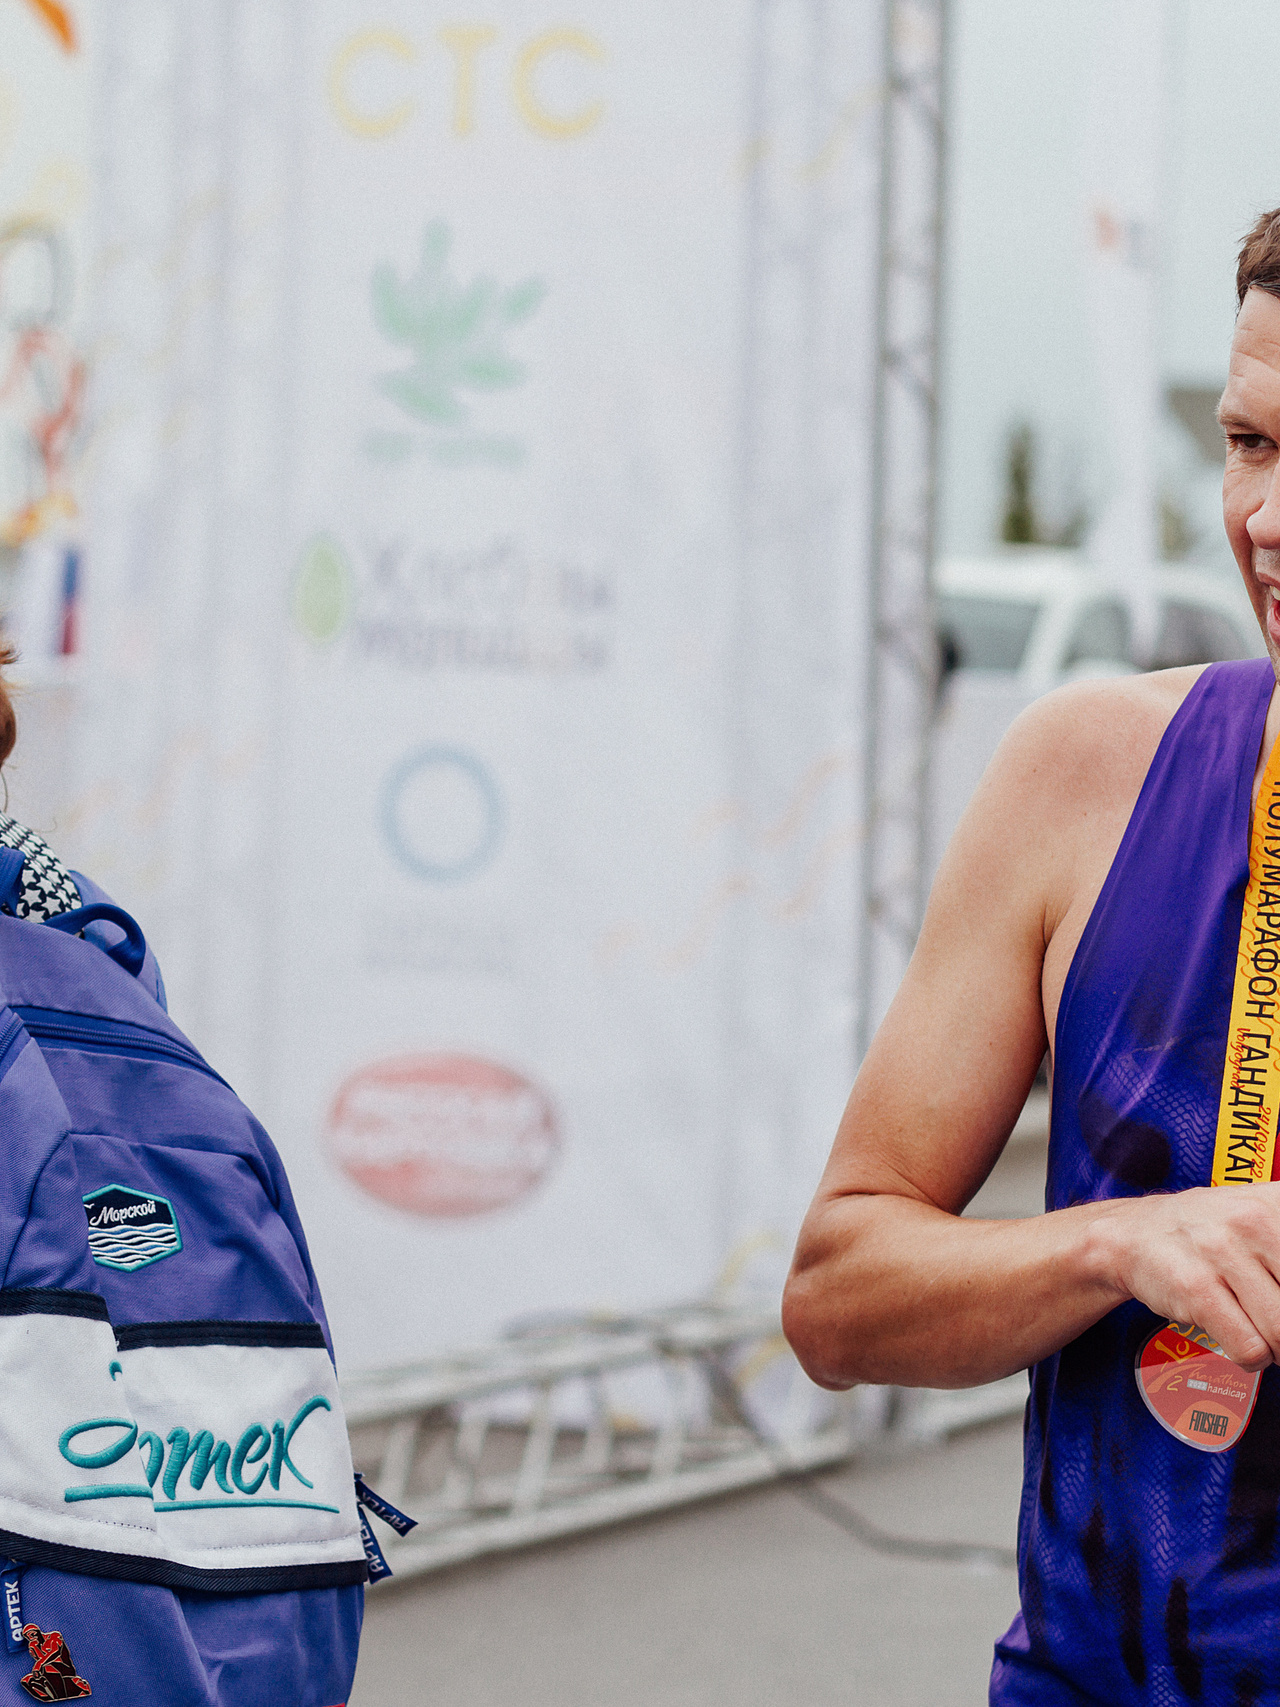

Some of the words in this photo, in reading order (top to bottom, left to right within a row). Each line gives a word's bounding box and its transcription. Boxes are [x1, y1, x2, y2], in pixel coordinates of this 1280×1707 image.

[1228, 1027, 1251, 1090] Volgograd
[1250, 1104, 1272, 1179] 24/09/22
[89, 1200, 156, 1226] Морской
[1207, 1382, 1247, 1402] handicap
[1188, 1409, 1229, 1438] FINISHER
[5, 1580, 24, 1642] АРТЕК
